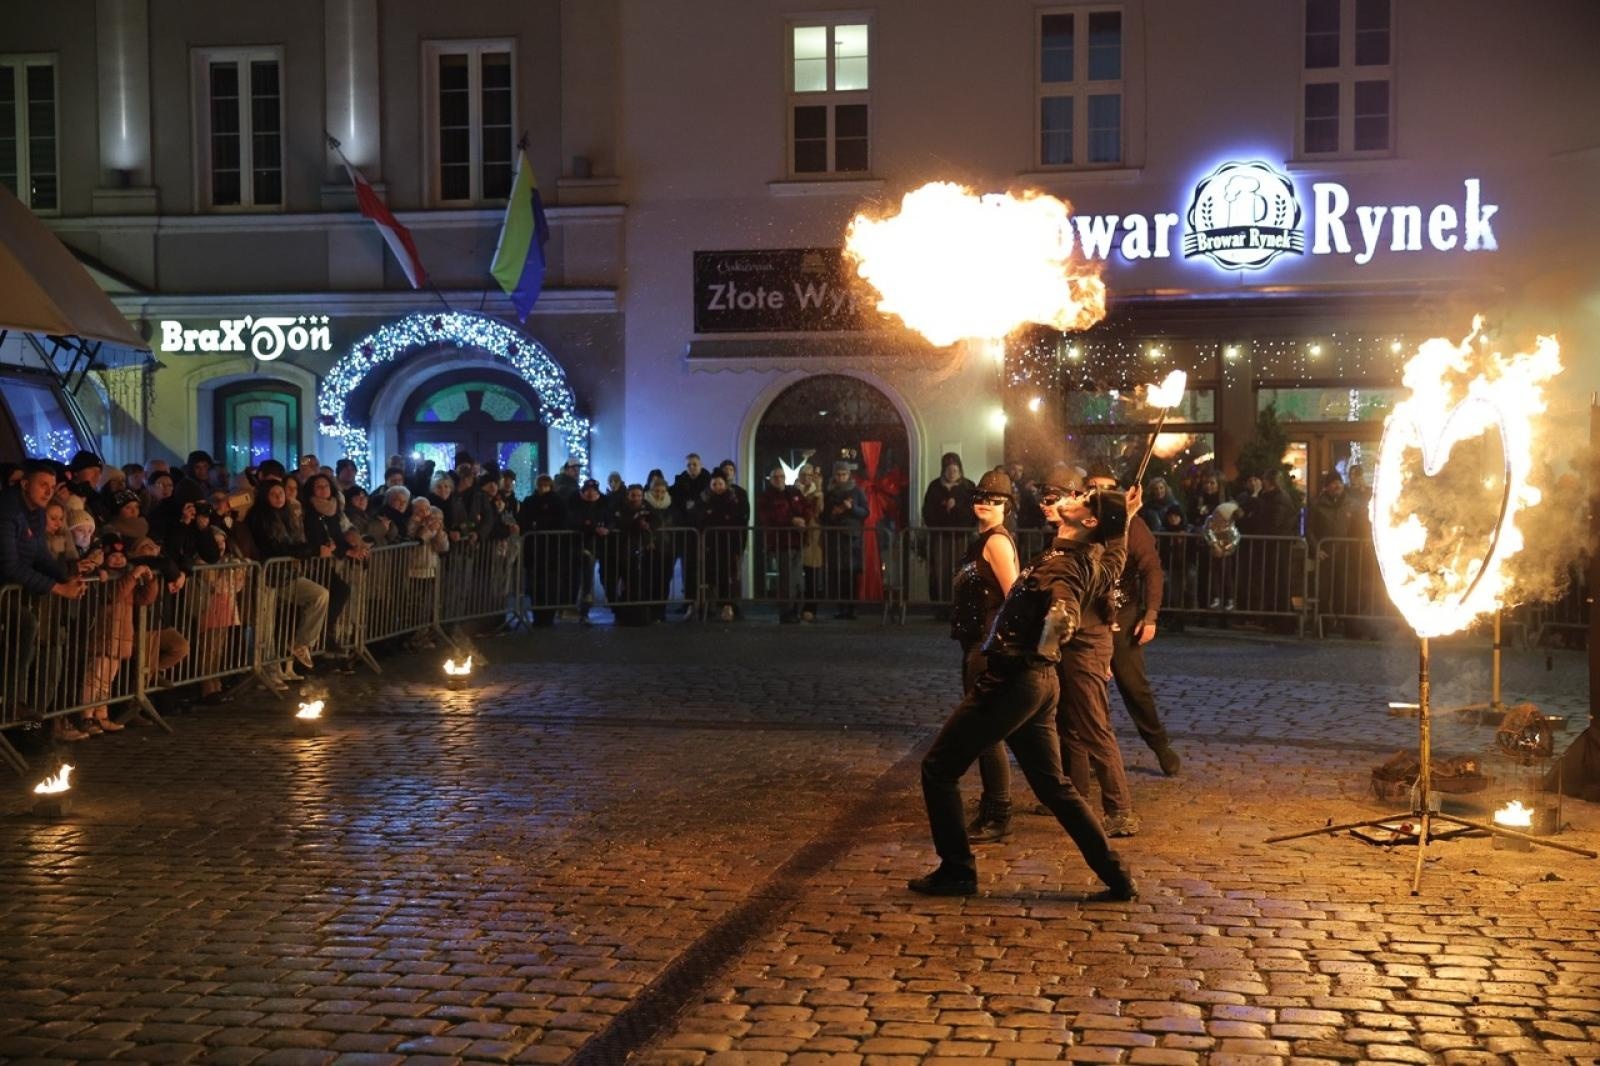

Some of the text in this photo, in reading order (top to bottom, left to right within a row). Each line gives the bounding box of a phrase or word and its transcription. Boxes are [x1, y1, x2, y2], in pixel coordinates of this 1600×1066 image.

[1312, 178, 1499, 265] Rynek
[1197, 228, 1291, 252] Browar Rynek
[707, 280, 785, 310] Złote
